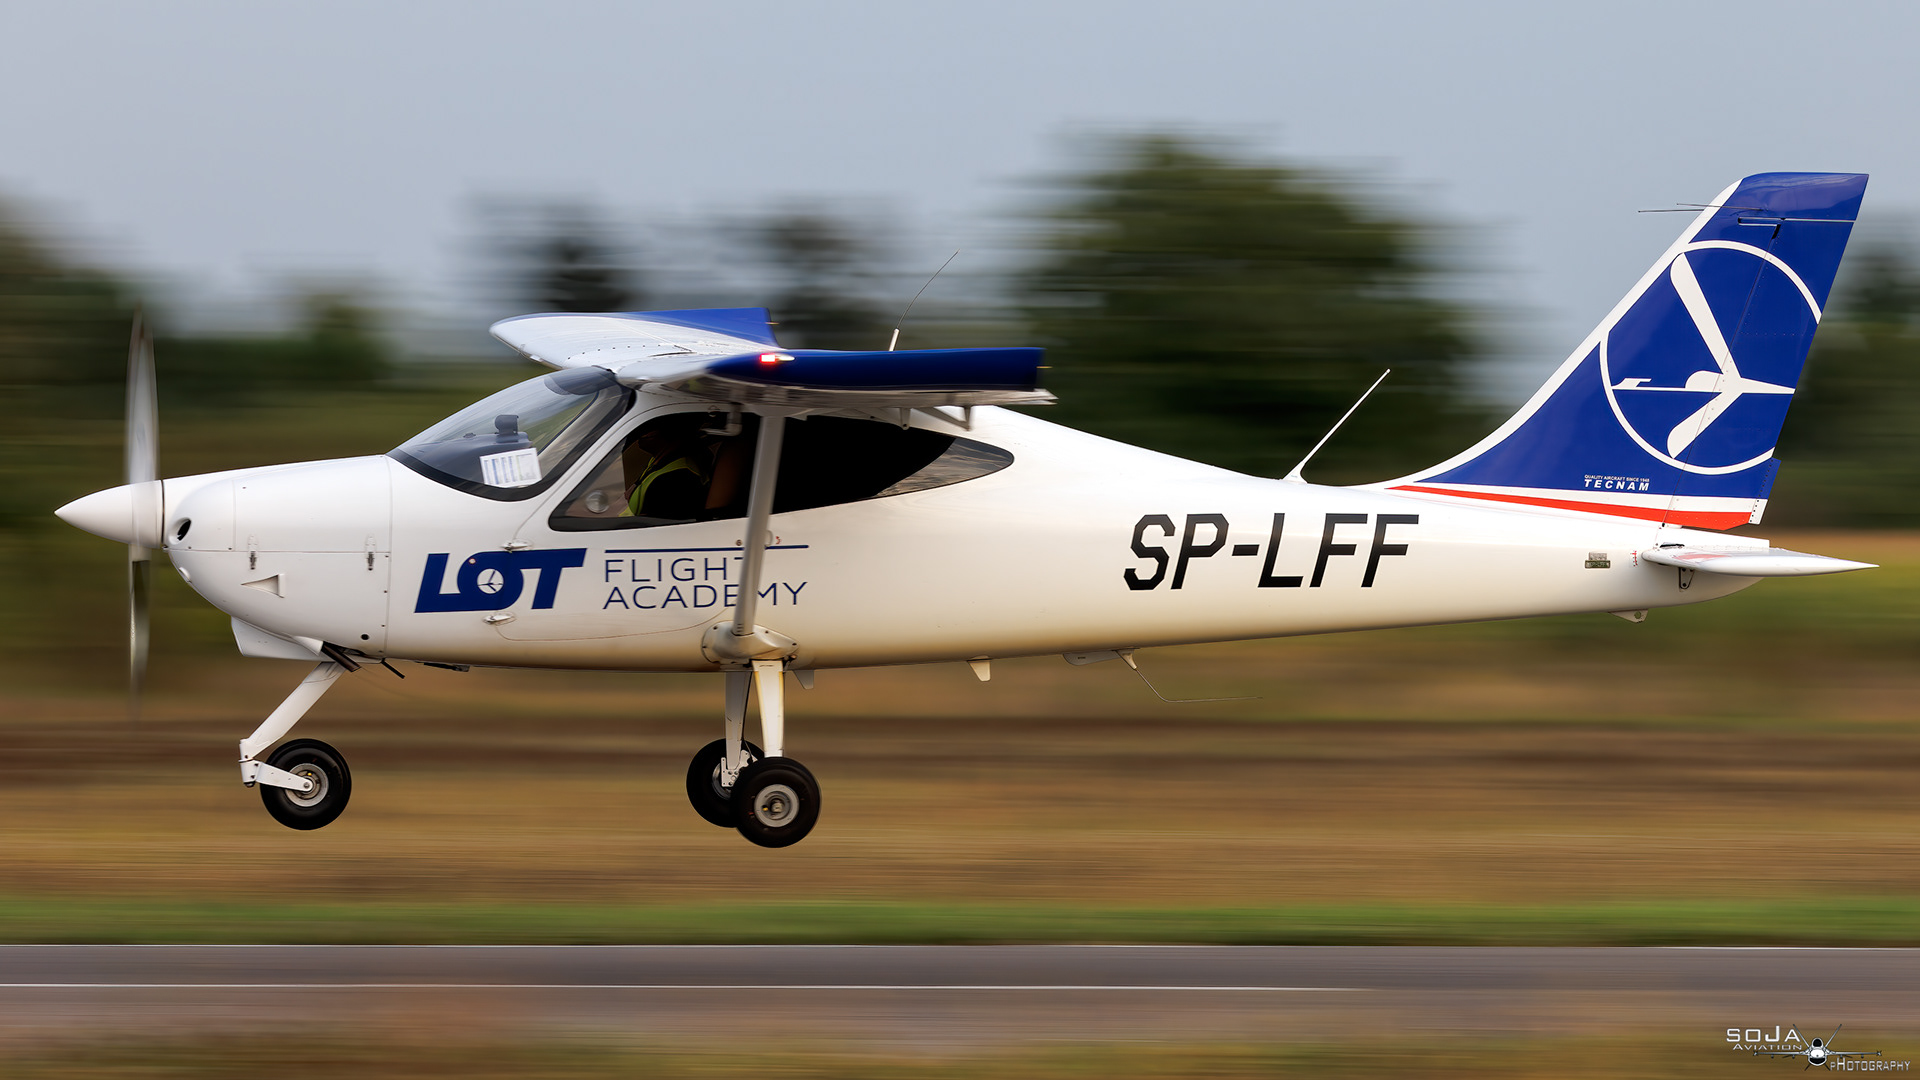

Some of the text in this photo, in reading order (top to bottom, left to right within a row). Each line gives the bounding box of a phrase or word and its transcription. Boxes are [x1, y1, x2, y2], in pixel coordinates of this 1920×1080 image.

[1584, 479, 1650, 491] TECNAM
[1123, 512, 1420, 591] SP-LFF
[413, 547, 588, 613] LOT
[602, 581, 808, 610] ACADEMY
